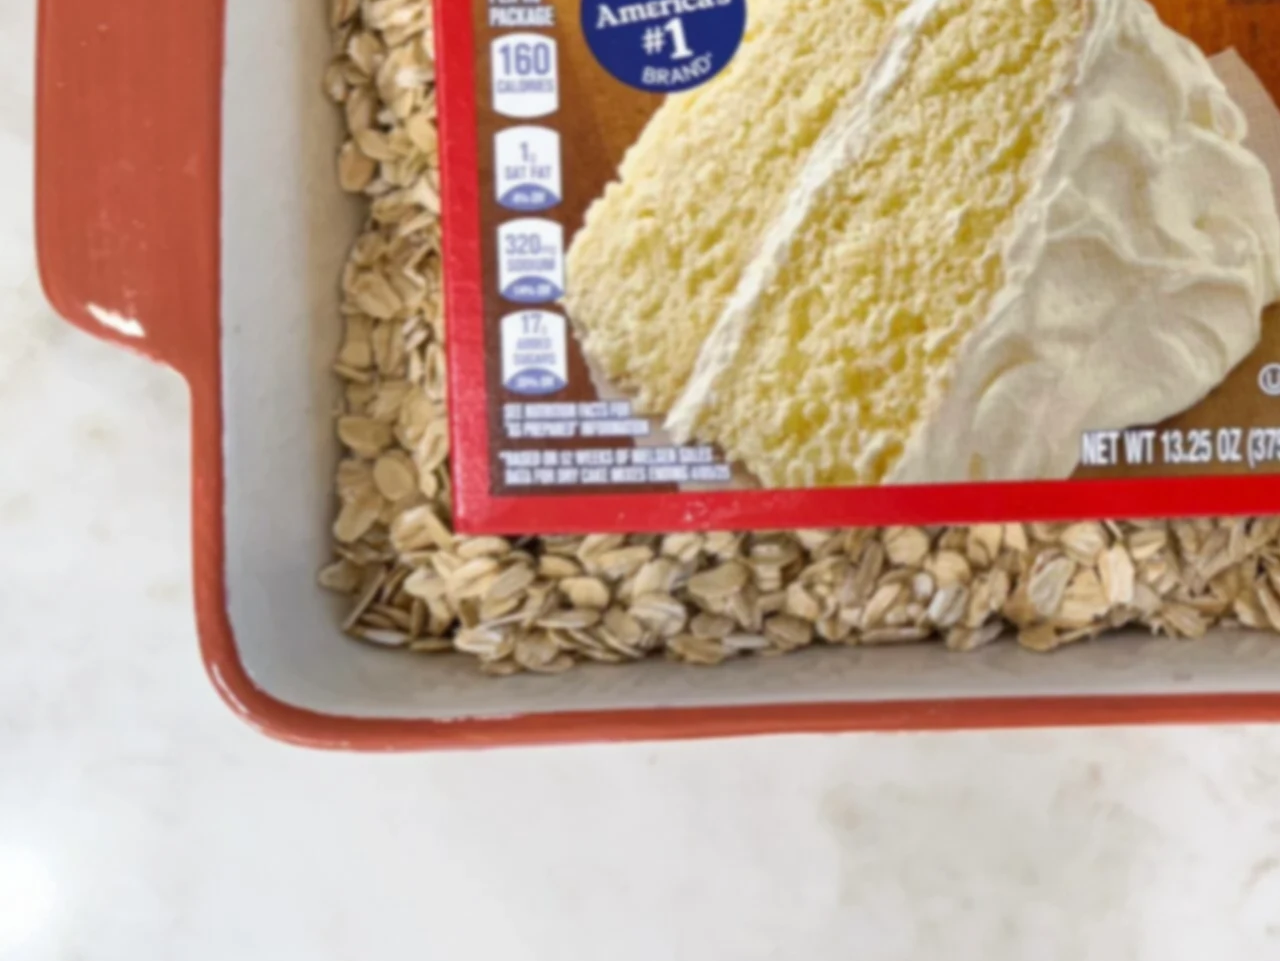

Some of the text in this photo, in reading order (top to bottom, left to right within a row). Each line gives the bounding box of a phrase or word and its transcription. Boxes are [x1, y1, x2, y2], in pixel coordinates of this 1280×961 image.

[641, 16, 695, 61] #1
[498, 42, 552, 77] 160
[1081, 431, 1119, 466] NET
[1123, 430, 1157, 465] WT
[1160, 429, 1213, 464] 13.25
[1216, 428, 1243, 463] OZ
